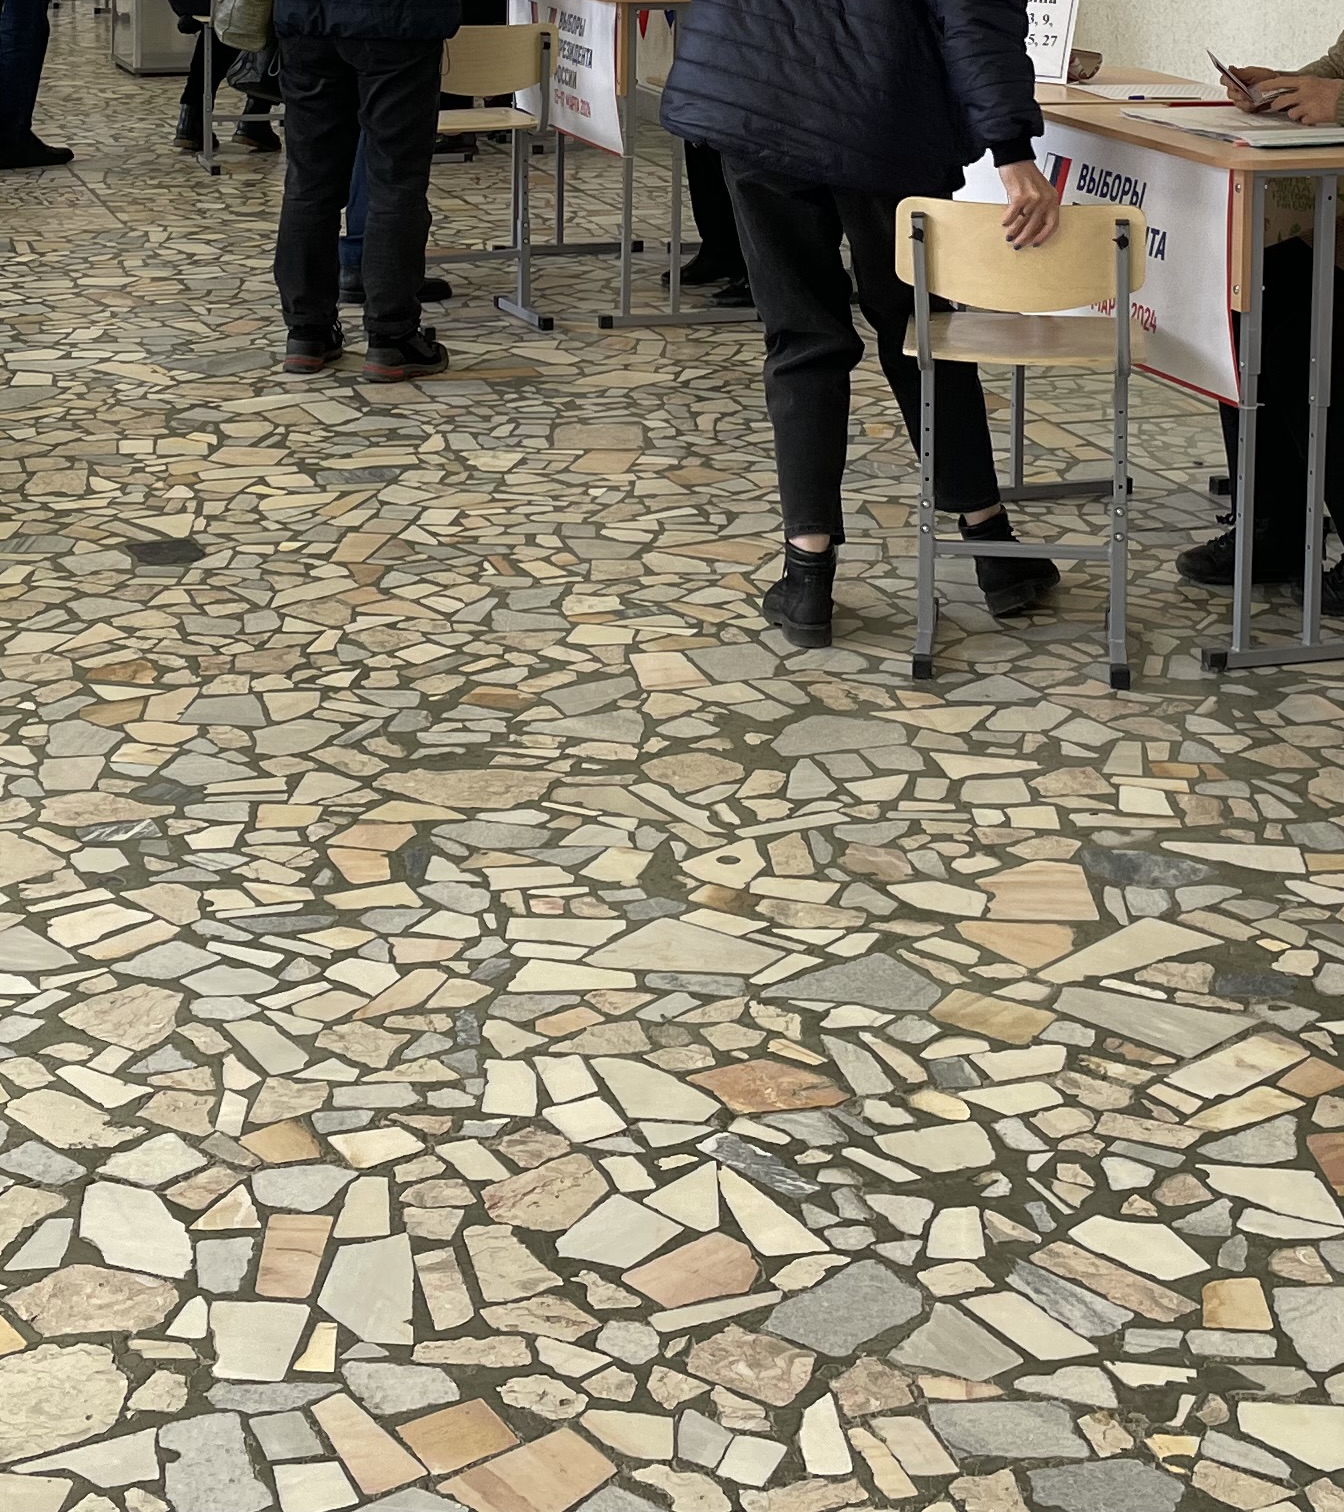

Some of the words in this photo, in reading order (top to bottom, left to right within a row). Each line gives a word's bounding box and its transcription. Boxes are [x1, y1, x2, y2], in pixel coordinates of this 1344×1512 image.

[1042, 13, 1053, 28] 9,
[1042, 34, 1058, 47] 27
[1076, 163, 1147, 209] ВЫБОРЫ
